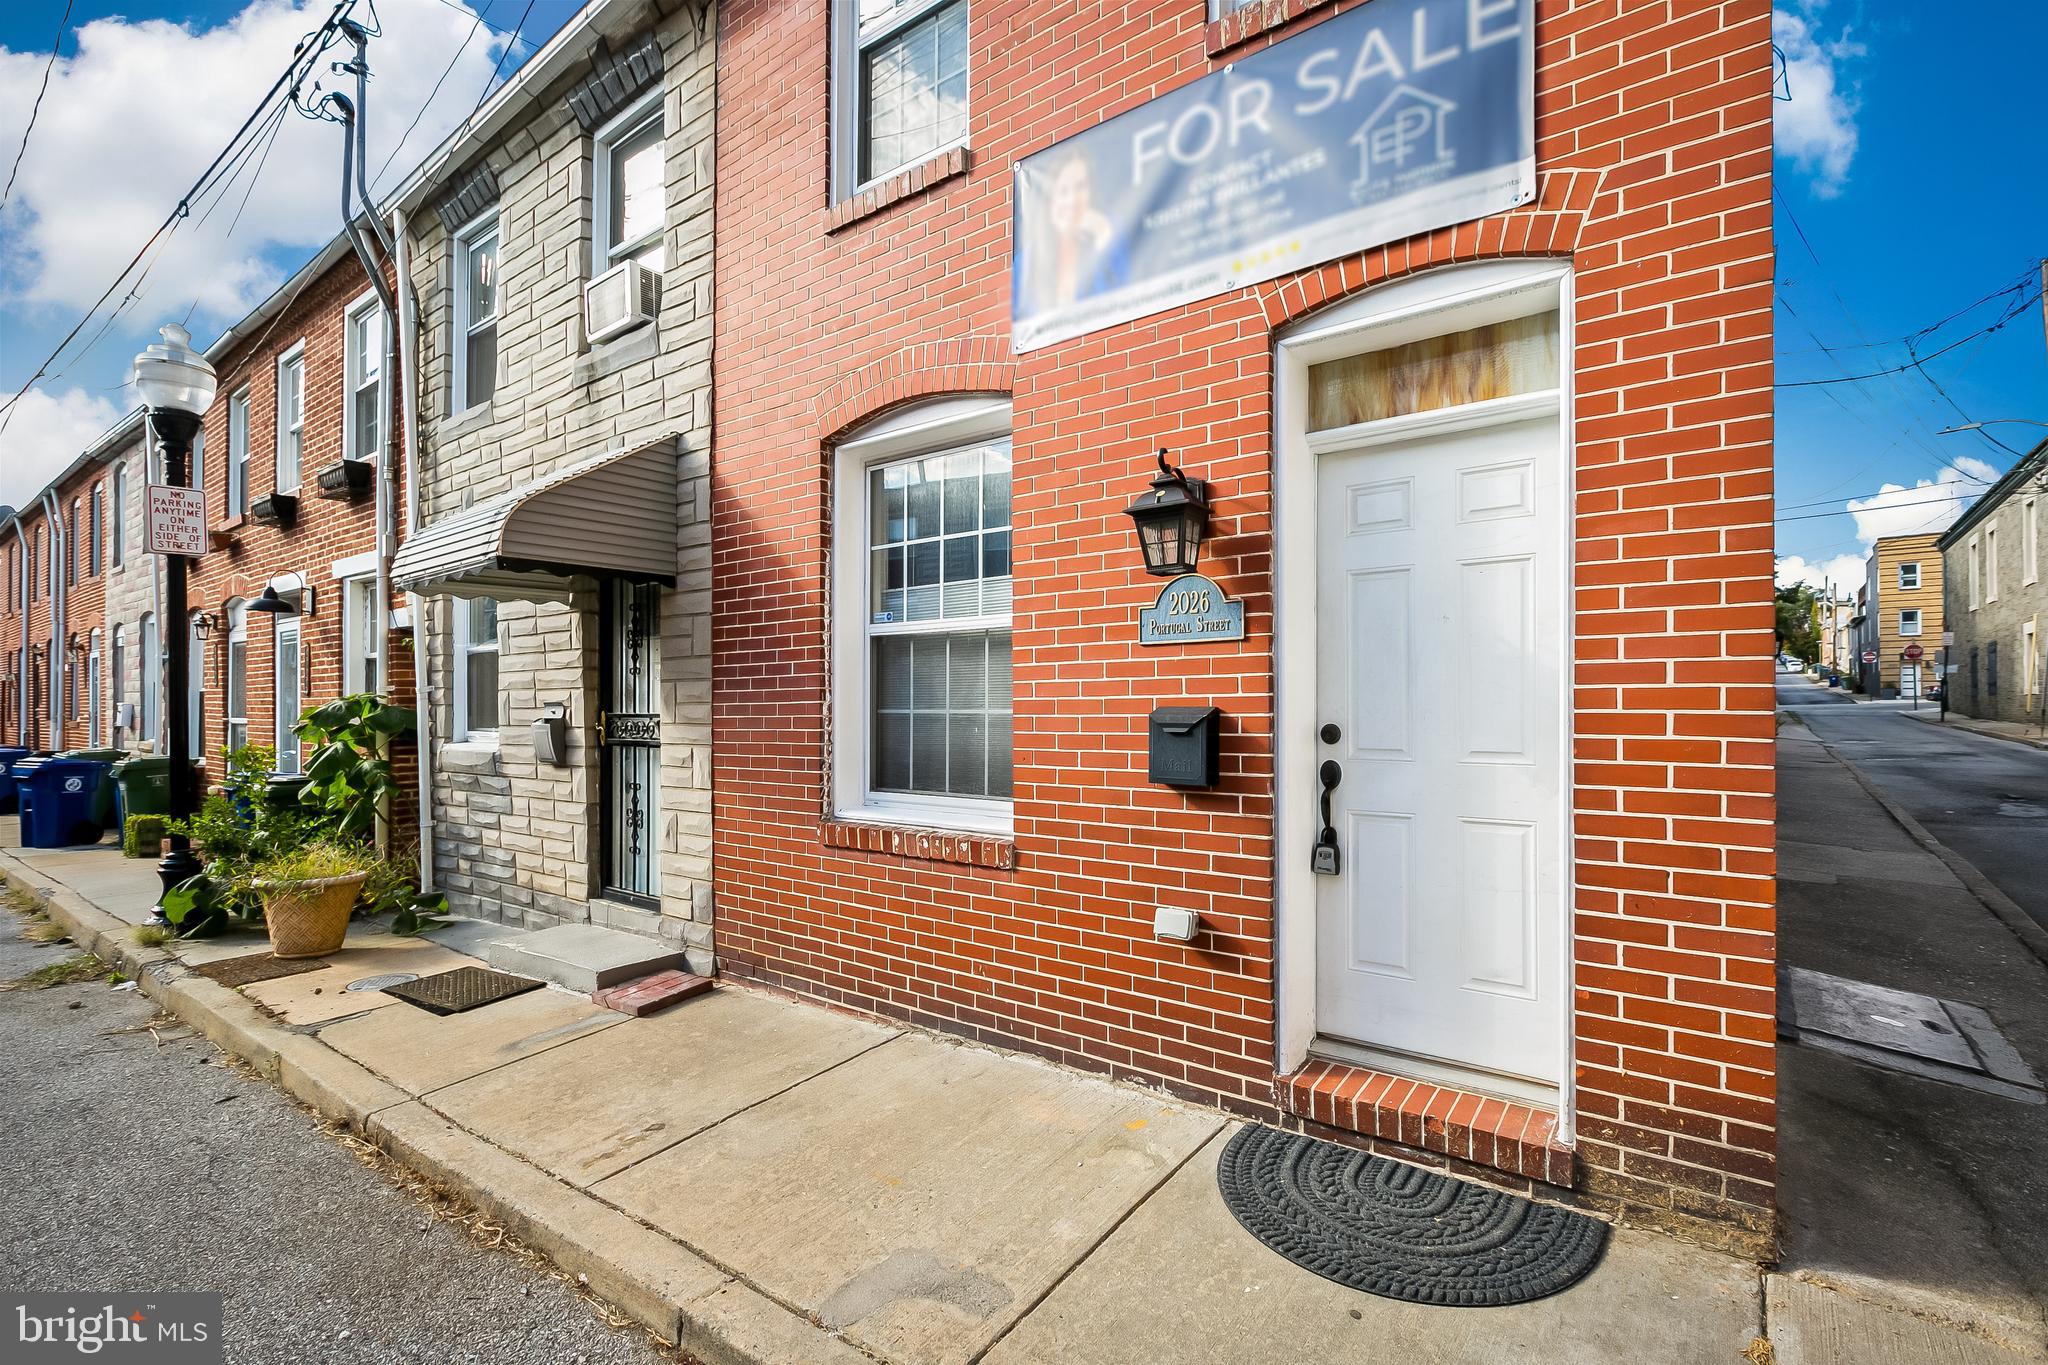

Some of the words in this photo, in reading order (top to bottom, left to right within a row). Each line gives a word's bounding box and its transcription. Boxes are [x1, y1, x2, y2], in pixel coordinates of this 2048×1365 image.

[1131, 78, 1273, 186] FOR
[1294, 0, 1523, 116] SALE
[170, 491, 185, 499] NO
[153, 498, 202, 509] PARKING
[154, 507, 201, 518] ANYTIME
[170, 516, 185, 524] ON
[159, 524, 198, 534] EITHER
[155, 532, 180, 541] SIDE
[189, 535, 202, 543] OF
[158, 541, 200, 550] STREET
[1169, 589, 1211, 616] 2026
[1160, 758, 1193, 772] Mail
